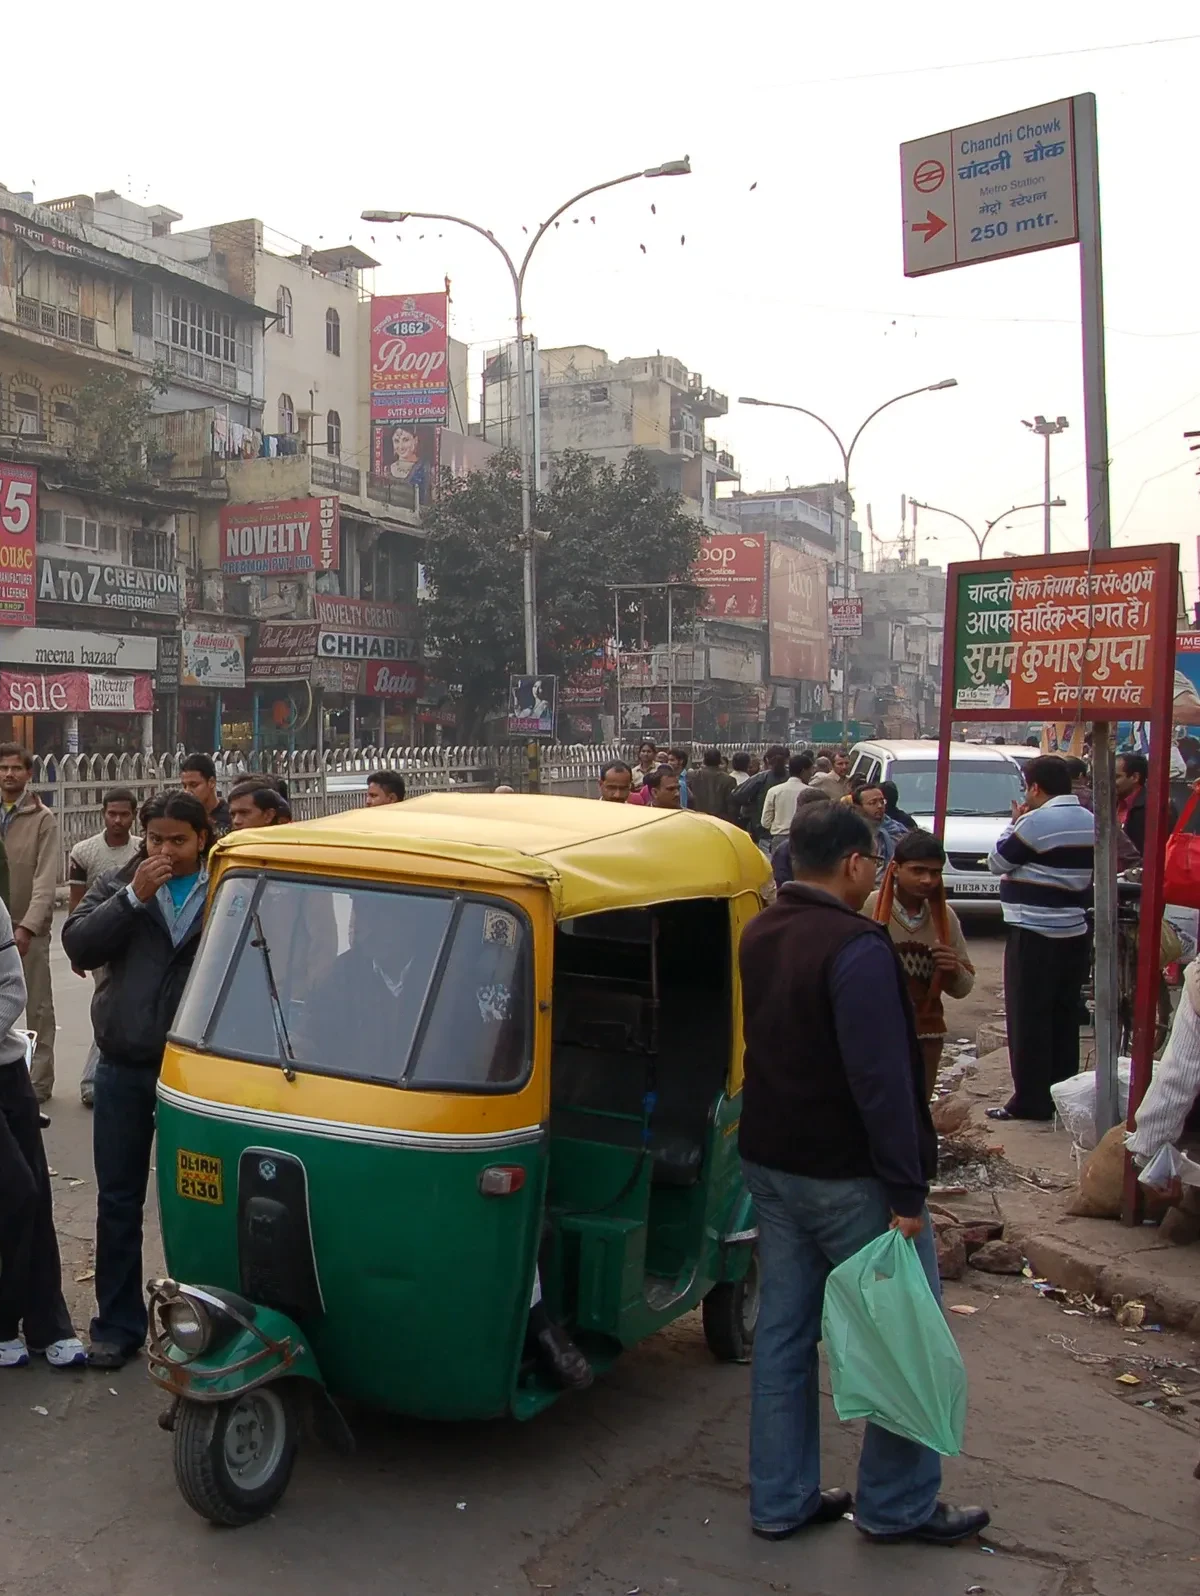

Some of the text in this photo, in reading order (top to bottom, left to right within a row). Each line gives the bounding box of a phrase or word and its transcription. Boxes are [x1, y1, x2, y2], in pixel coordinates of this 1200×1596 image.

[961, 117, 1061, 155] Chandni Chowk
[957, 140, 1066, 180] चांदनी चौक
[979, 175, 1045, 197] Metro Station
[978, 191, 1048, 215] मेट्रो स्टेशन
[970, 212, 1058, 243] 250 mtr.
[394, 322, 424, 335] 1862
[373, 338, 445, 379] Roop
[373, 372, 418, 381] Saree
[373, 381, 445, 390] Creation
[388, 408, 407, 417] SUITS
[227, 522, 311, 557] NOVELTY
[320, 498, 333, 568] NOVELTY
[40, 559, 177, 604] A TO Z CREATION
[1042, 573, 1078, 599] निगम
[319, 603, 362, 625] NOVELTY
[966, 610, 1021, 635] आपका
[1066, 603, 1128, 630] स्वागत
[36, 646, 118, 665] meena bazaar
[321, 634, 420, 660] CHHABRA
[963, 634, 1151, 684] सुमन कुमार गुप्ता
[9, 674, 67, 711] sale
[94, 677, 129, 693] meena
[374, 666, 417, 694] Bata
[1053, 681, 1144, 705] निगम पार्षद
[181, 1179, 218, 1199] 2130
